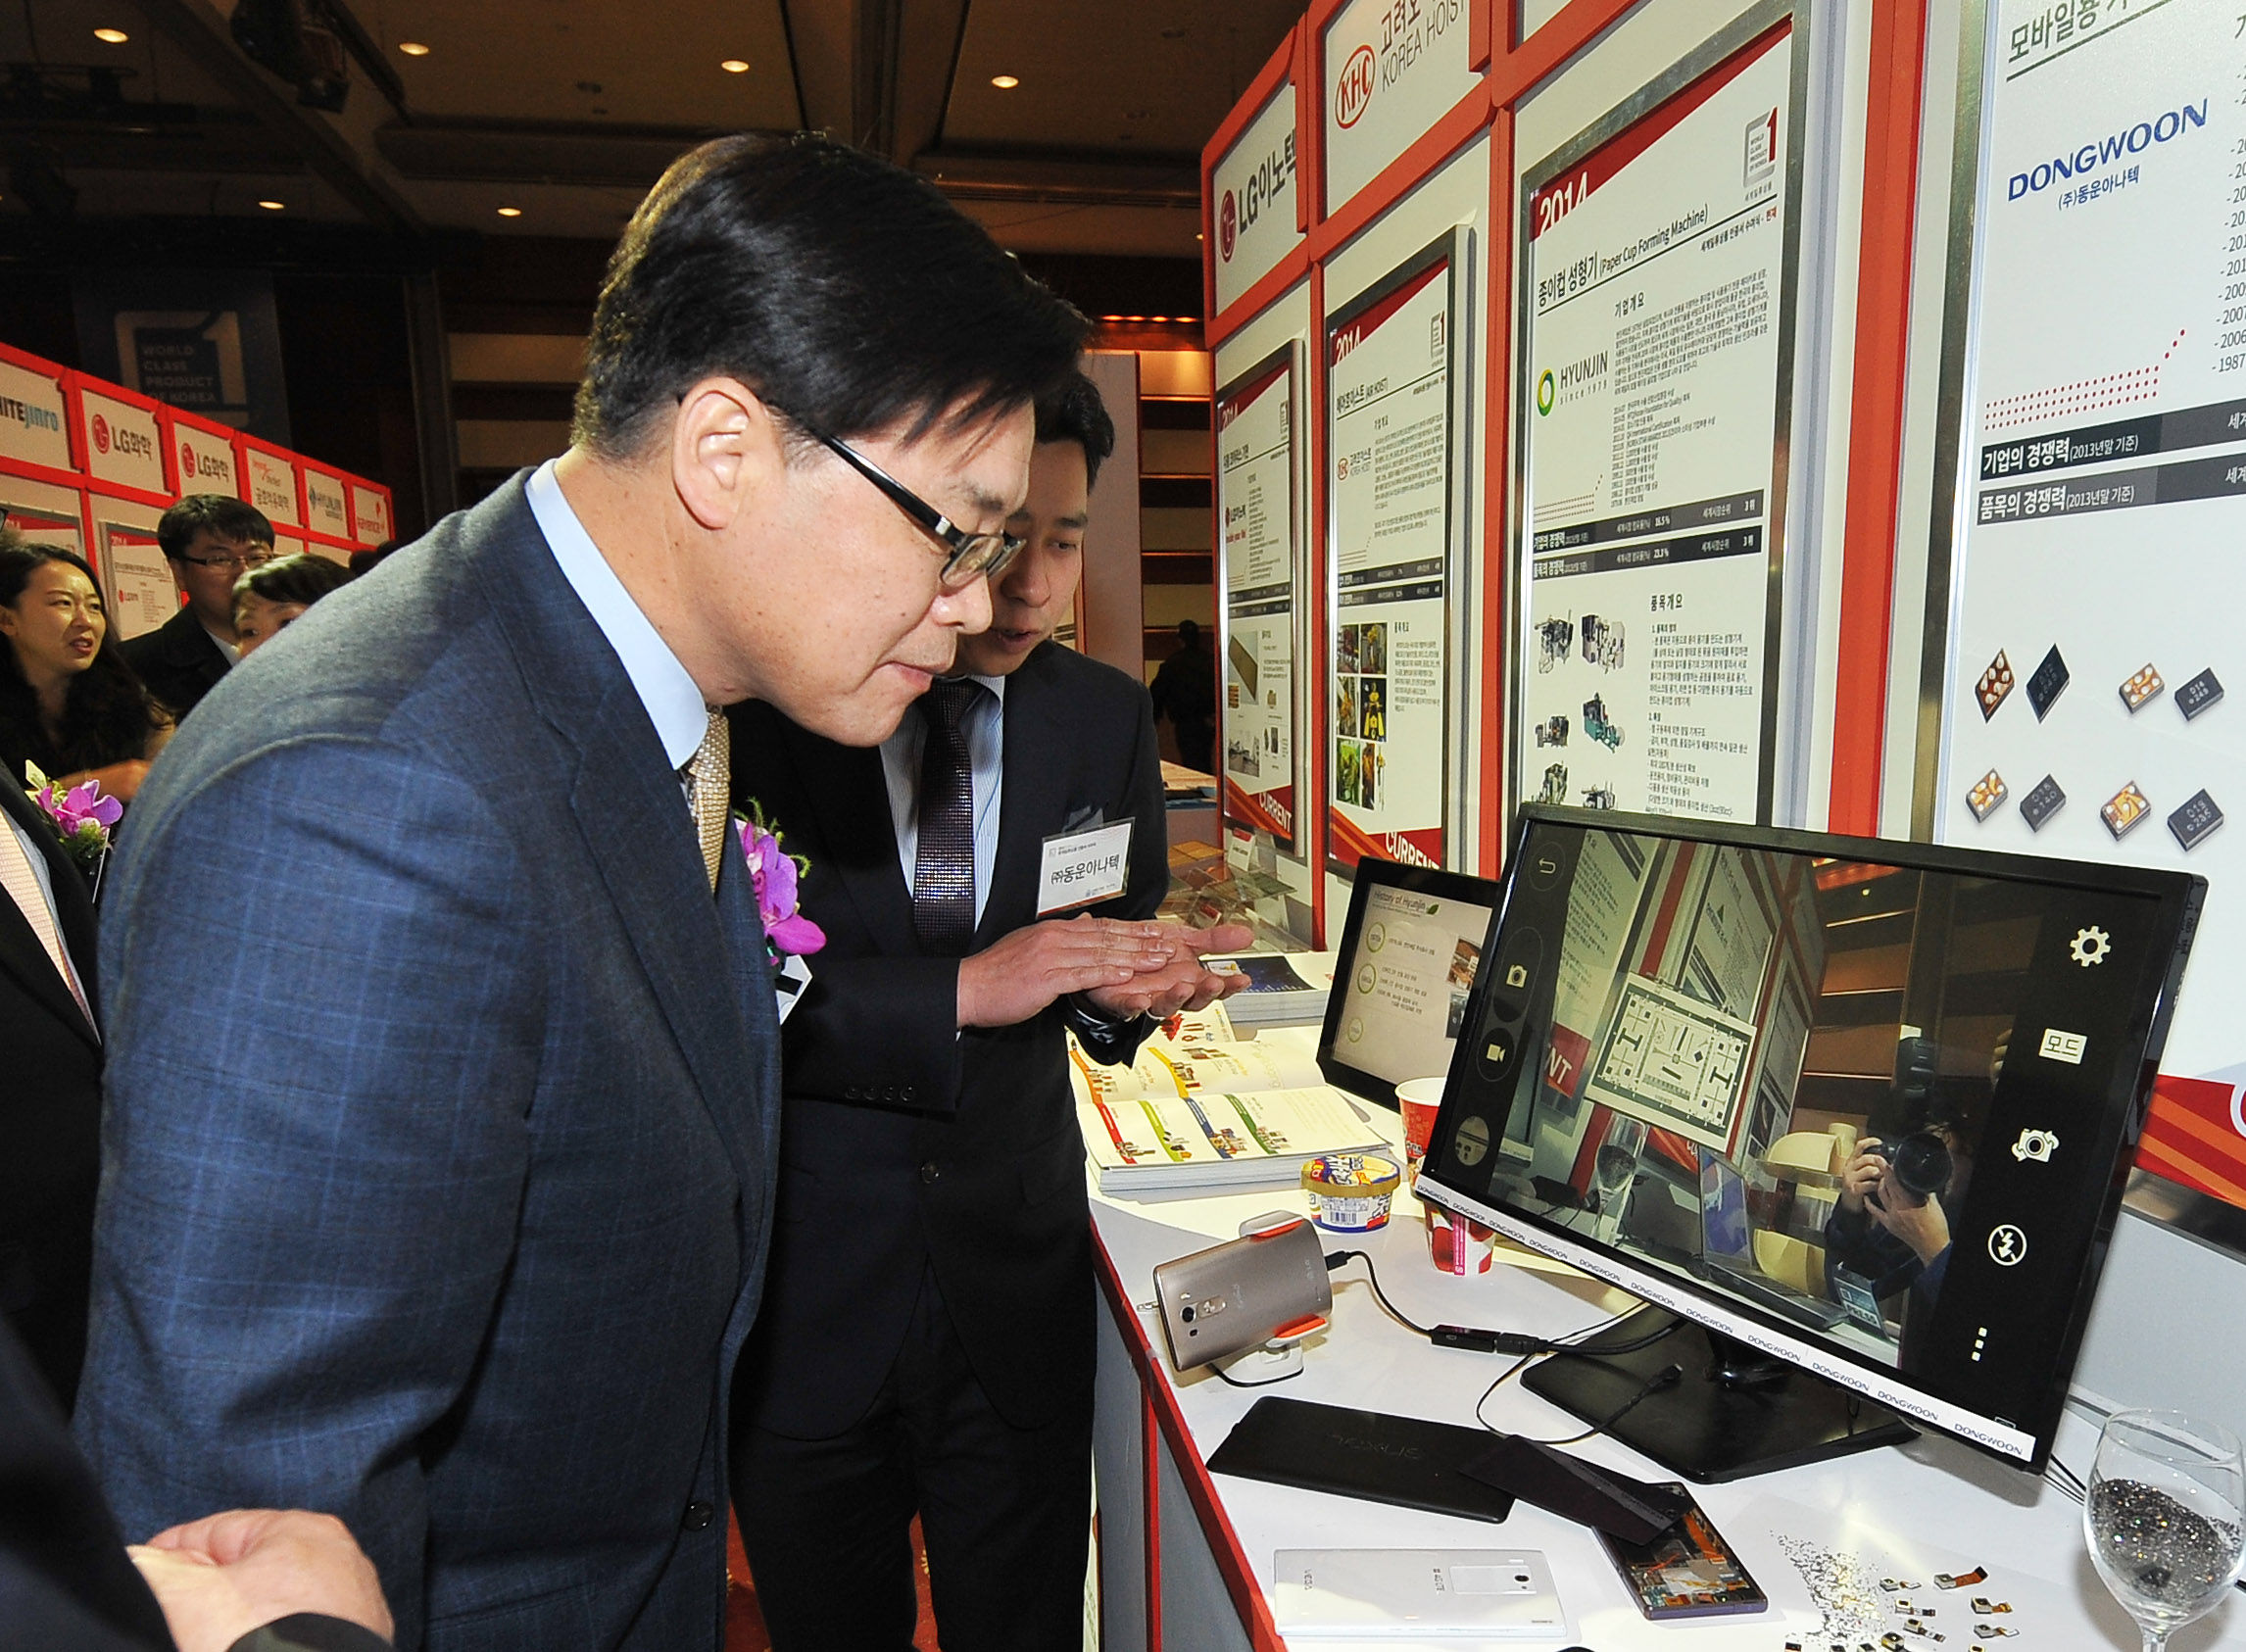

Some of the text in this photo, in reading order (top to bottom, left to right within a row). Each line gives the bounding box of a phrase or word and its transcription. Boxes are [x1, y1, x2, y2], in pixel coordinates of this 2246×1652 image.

[1382, 27, 1422, 92] KOREA
[1340, 54, 1371, 121] KHC
[2008, 98, 2208, 201] DONGWOON
[1539, 171, 1587, 235] 2014
[2058, 165, 2140, 211] (주)동운아나텍
[1538, 204, 1708, 307] 종이컵 성형기 (Paper Cup Forming Machine)
[142, 345, 195, 356] WORLD
[1337, 325, 1360, 363] 2014
[144, 361, 188, 370] CLASS
[1560, 351, 1608, 390] HYUNJIN
[146, 376, 214, 386] PRODUCT
[170, 392, 216, 402] KOREA
[1983, 444, 2024, 475] 기업의
[1980, 491, 2020, 520] 품목의
[1651, 594, 1683, 611] 품목개요
[1259, 792, 1293, 833] CURRENT
[2044, 1035, 2080, 1056] 모드
[1579, 1258, 1622, 1283] DONGWOON
[1631, 1282, 1676, 1308] DONGWOON
[1685, 1307, 1734, 1336] DONGWOON
[1747, 1334, 1801, 1363] DONGWOON
[1812, 1362, 1870, 1392] DONGWOON
[1878, 1389, 1939, 1421] DONGWOON
[1954, 1423, 2024, 1456] DONGWOON
